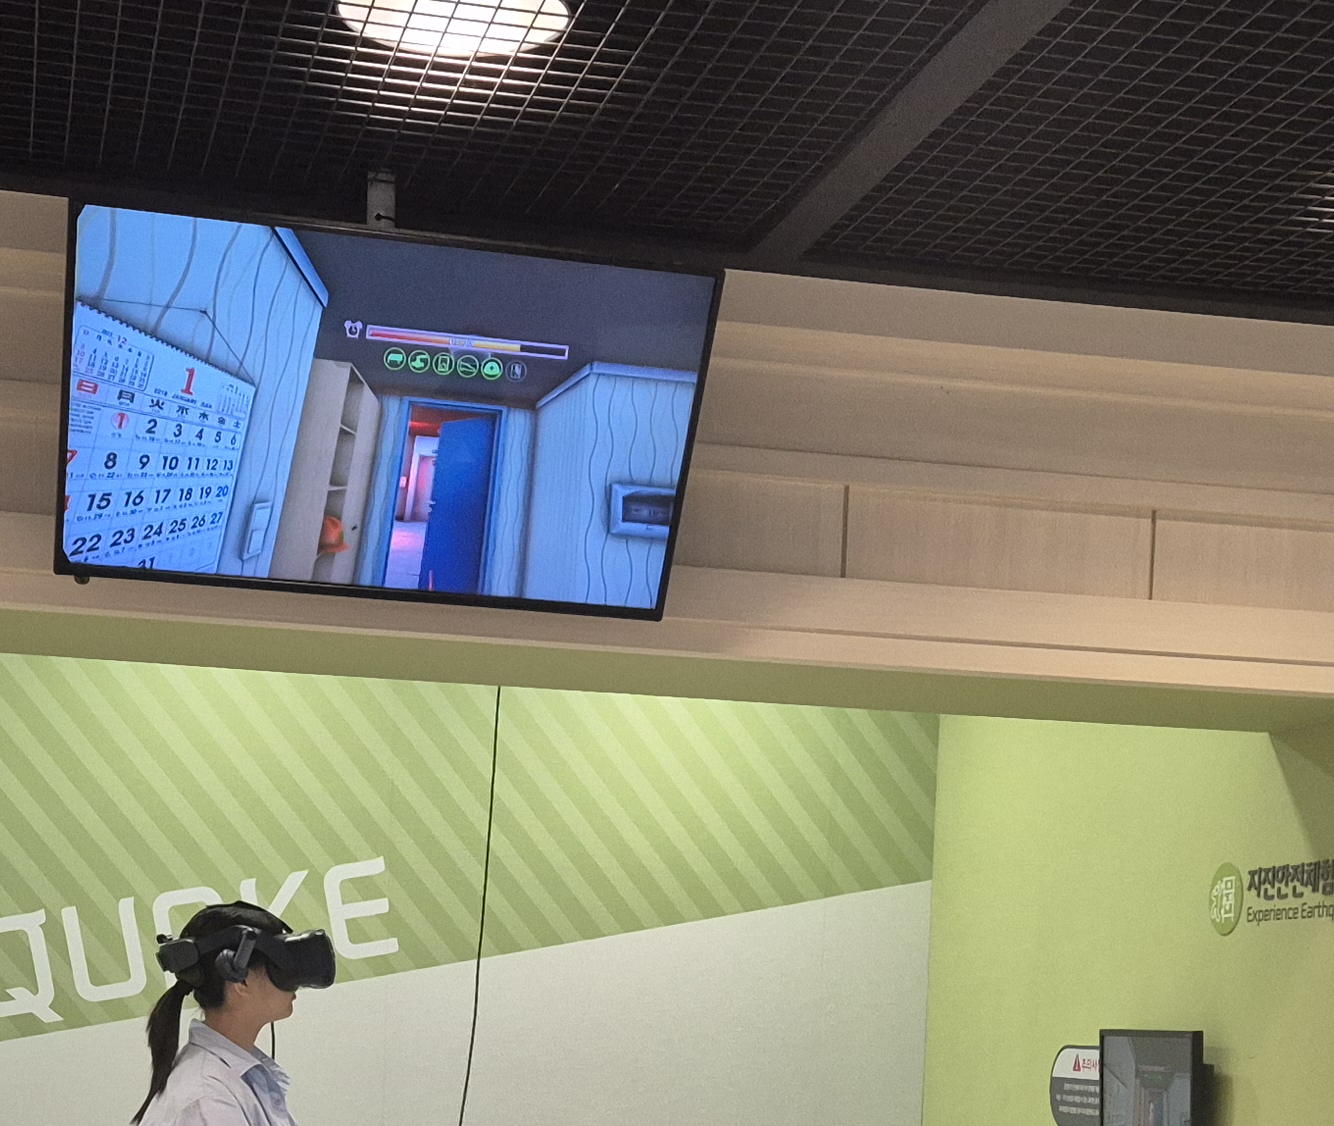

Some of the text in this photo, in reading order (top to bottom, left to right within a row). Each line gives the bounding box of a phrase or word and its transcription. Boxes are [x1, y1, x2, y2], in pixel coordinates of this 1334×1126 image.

[181, 367, 196, 396] 1
[76, 378, 99, 395] 日
[117, 389, 135, 404] 月
[149, 397, 165, 410] 火
[233, 420, 242, 429] 土
[145, 419, 158, 434] 2
[173, 424, 183, 438] 3
[195, 428, 204, 441] 4
[214, 431, 222, 443] 5
[230, 434, 237, 446] 6
[104, 452, 118, 470] 8
[139, 454, 150, 470] 9
[162, 456, 179, 471] 10
[187, 457, 200, 471] 11
[205, 458, 218, 471] 12
[223, 459, 234, 471] 13
[86, 492, 112, 511] 15
[124, 490, 144, 507] 16
[154, 488, 171, 504] 17
[178, 487, 193, 501] 18
[199, 486, 212, 499] 19
[215, 485, 229, 498] 20
[69, 533, 102, 557] 22
[109, 528, 135, 548] 23
[142, 522, 164, 541] 24
[168, 518, 187, 534] 25
[190, 514, 206, 529] 26
[209, 511, 223, 525] 27
[1247, 858, 1334, 901] 지진안전체험
[1247, 904, 1298, 926] Experience
